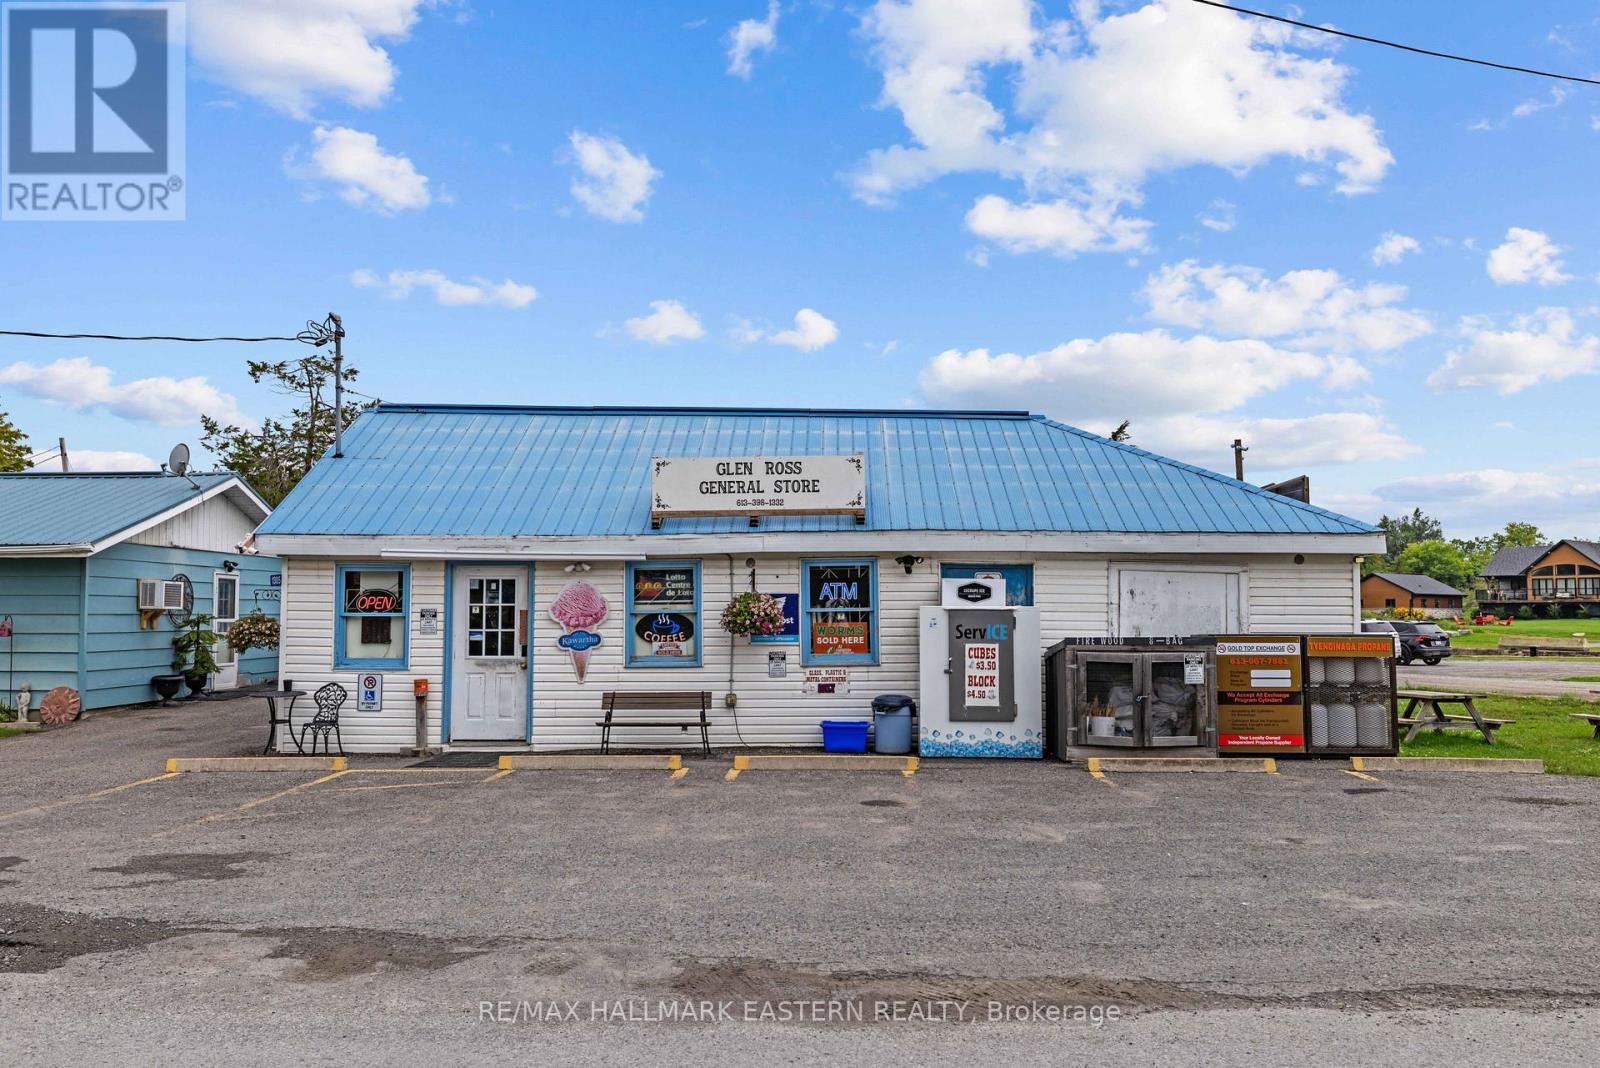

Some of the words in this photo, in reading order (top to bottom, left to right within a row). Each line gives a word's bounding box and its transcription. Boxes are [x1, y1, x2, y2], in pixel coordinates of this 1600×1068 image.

[716, 462, 753, 476] GLEN
[764, 461, 802, 475] ROSS
[700, 480, 764, 494] GENERAL
[774, 479, 820, 493] STORE
[736, 499, 784, 507] 613-398-1332
[820, 582, 858, 600] ATM
[358, 596, 393, 610] OPEN
[644, 631, 686, 642] COFFEE
[816, 626, 864, 636] WORMS
[956, 624, 1008, 641] ServICE
[562, 636, 598, 645] Kawartha
[1358, 642, 1392, 651] PROPANE
[968, 647, 996, 659] CUBES
[976, 661, 996, 670] $3.50
[967, 675, 996, 687] BLOCK
[967, 690, 986, 700] $4.50
